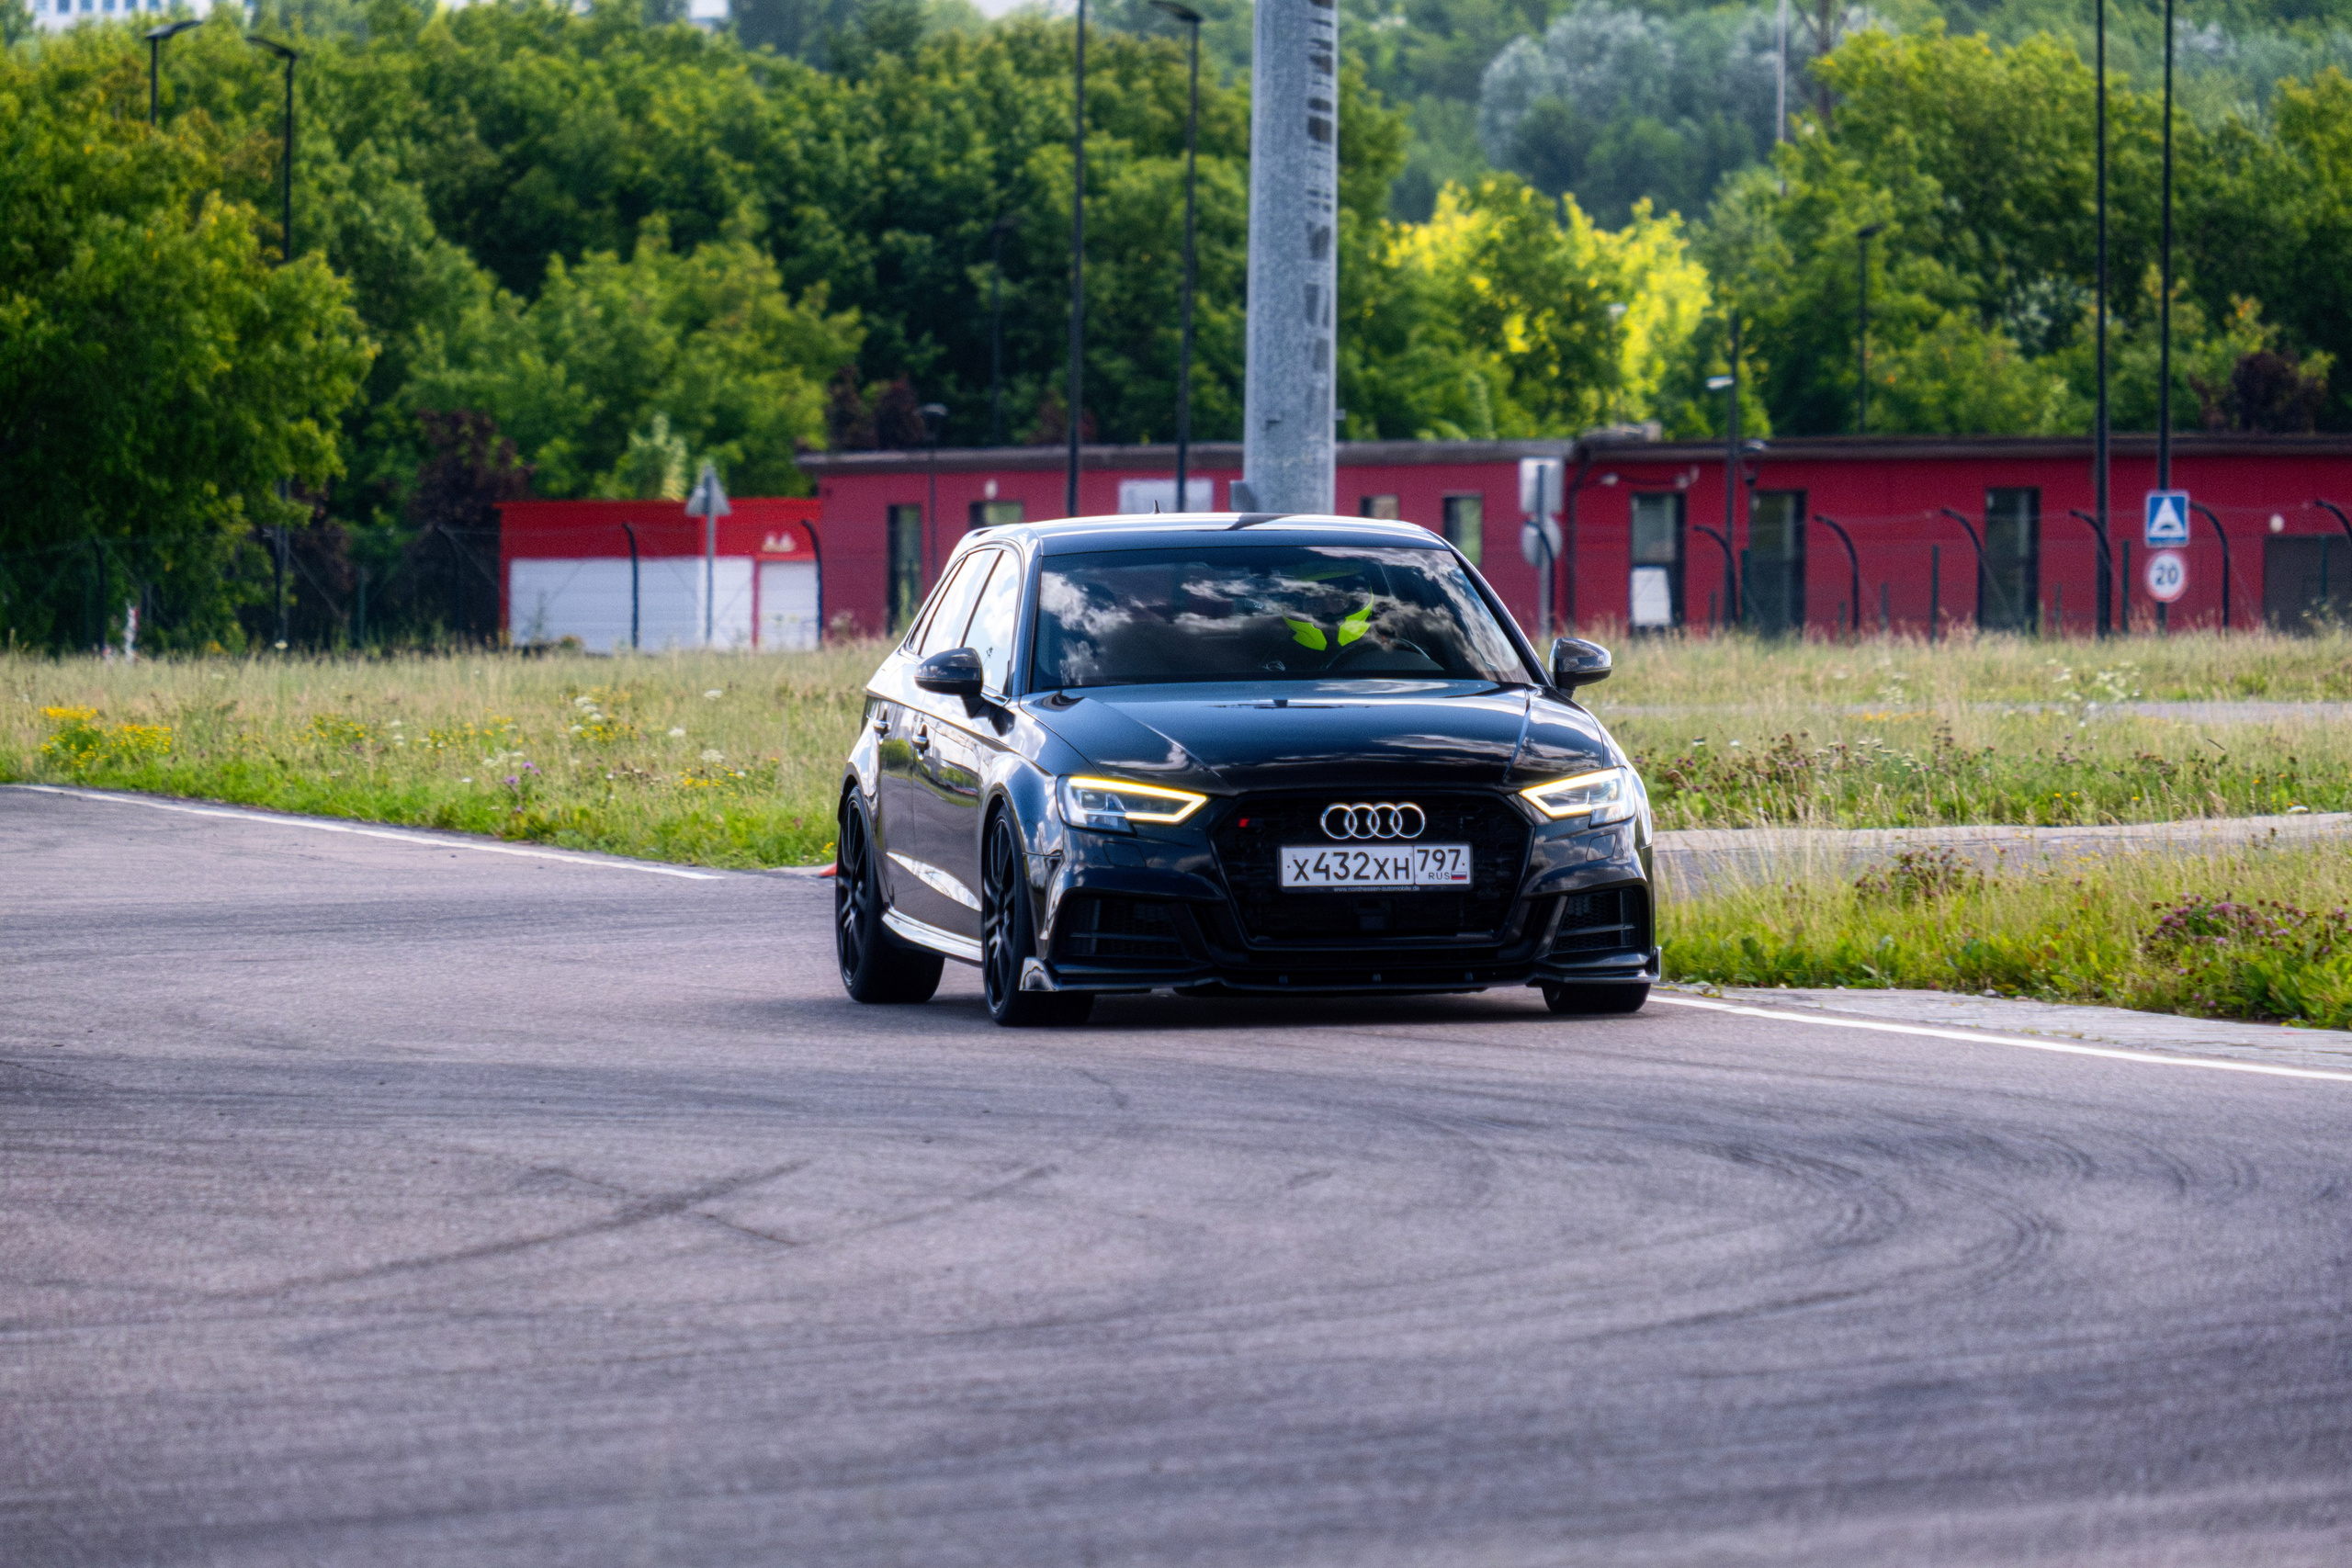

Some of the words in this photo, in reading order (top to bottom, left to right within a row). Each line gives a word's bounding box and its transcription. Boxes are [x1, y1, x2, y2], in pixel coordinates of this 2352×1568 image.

[2155, 563, 2179, 585] 20
[1417, 849, 1462, 871] 797
[1428, 872, 1450, 880] RUS
